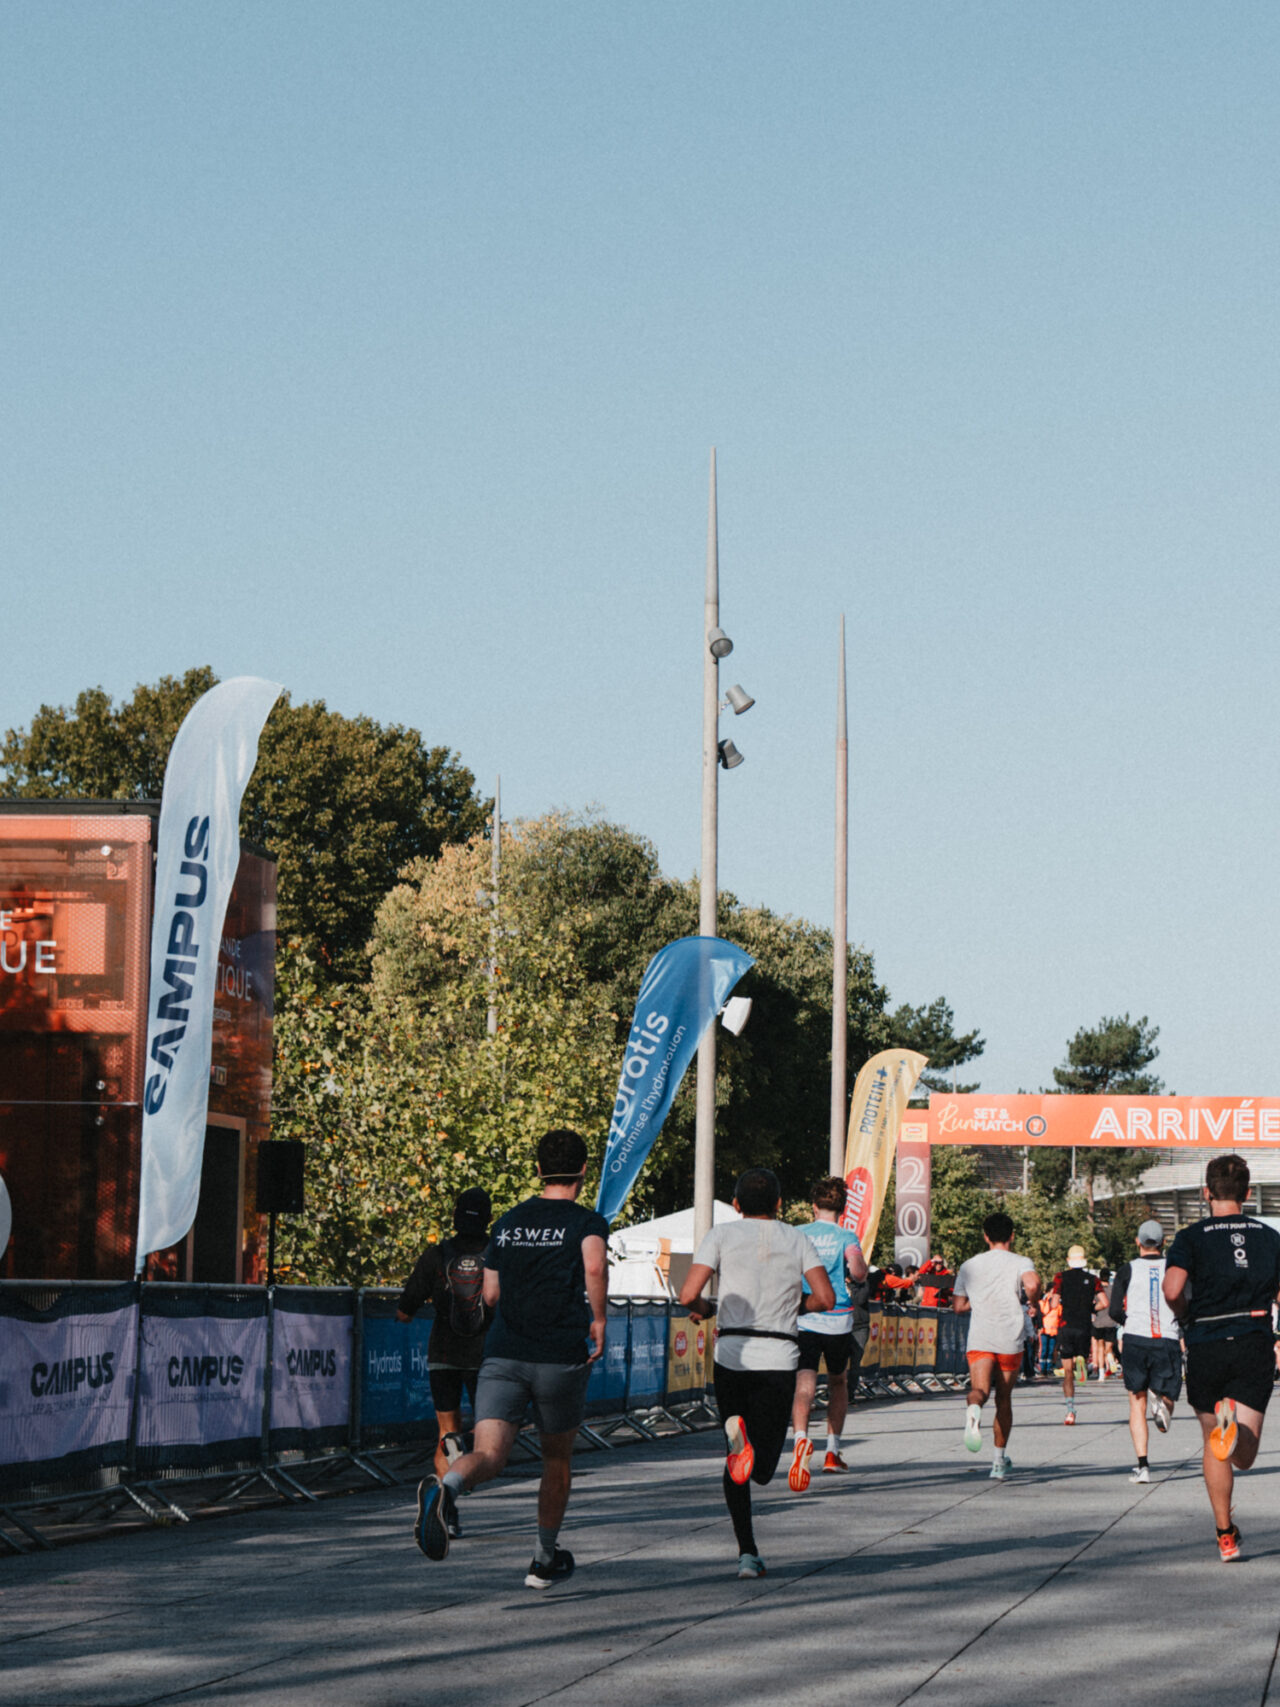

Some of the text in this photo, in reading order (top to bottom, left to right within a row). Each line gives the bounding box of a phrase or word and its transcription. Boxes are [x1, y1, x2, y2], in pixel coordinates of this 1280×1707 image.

[144, 815, 210, 1116] CAMPUS
[215, 963, 252, 1002] TIQUE
[937, 1101, 974, 1135] Run
[973, 1108, 1010, 1119] SET &
[974, 1120, 1023, 1132] MATCH
[1091, 1100, 1280, 1141] ARRIVÉE
[610, 1111, 649, 1173] Optimise
[844, 1177, 868, 1231] arilla
[512, 1227, 566, 1241] SWEN
[30, 1351, 114, 1397] CAMPUS
[168, 1354, 245, 1387] CAMPUS
[287, 1348, 337, 1378] CAMPUS
[368, 1349, 402, 1380] Hydratis
